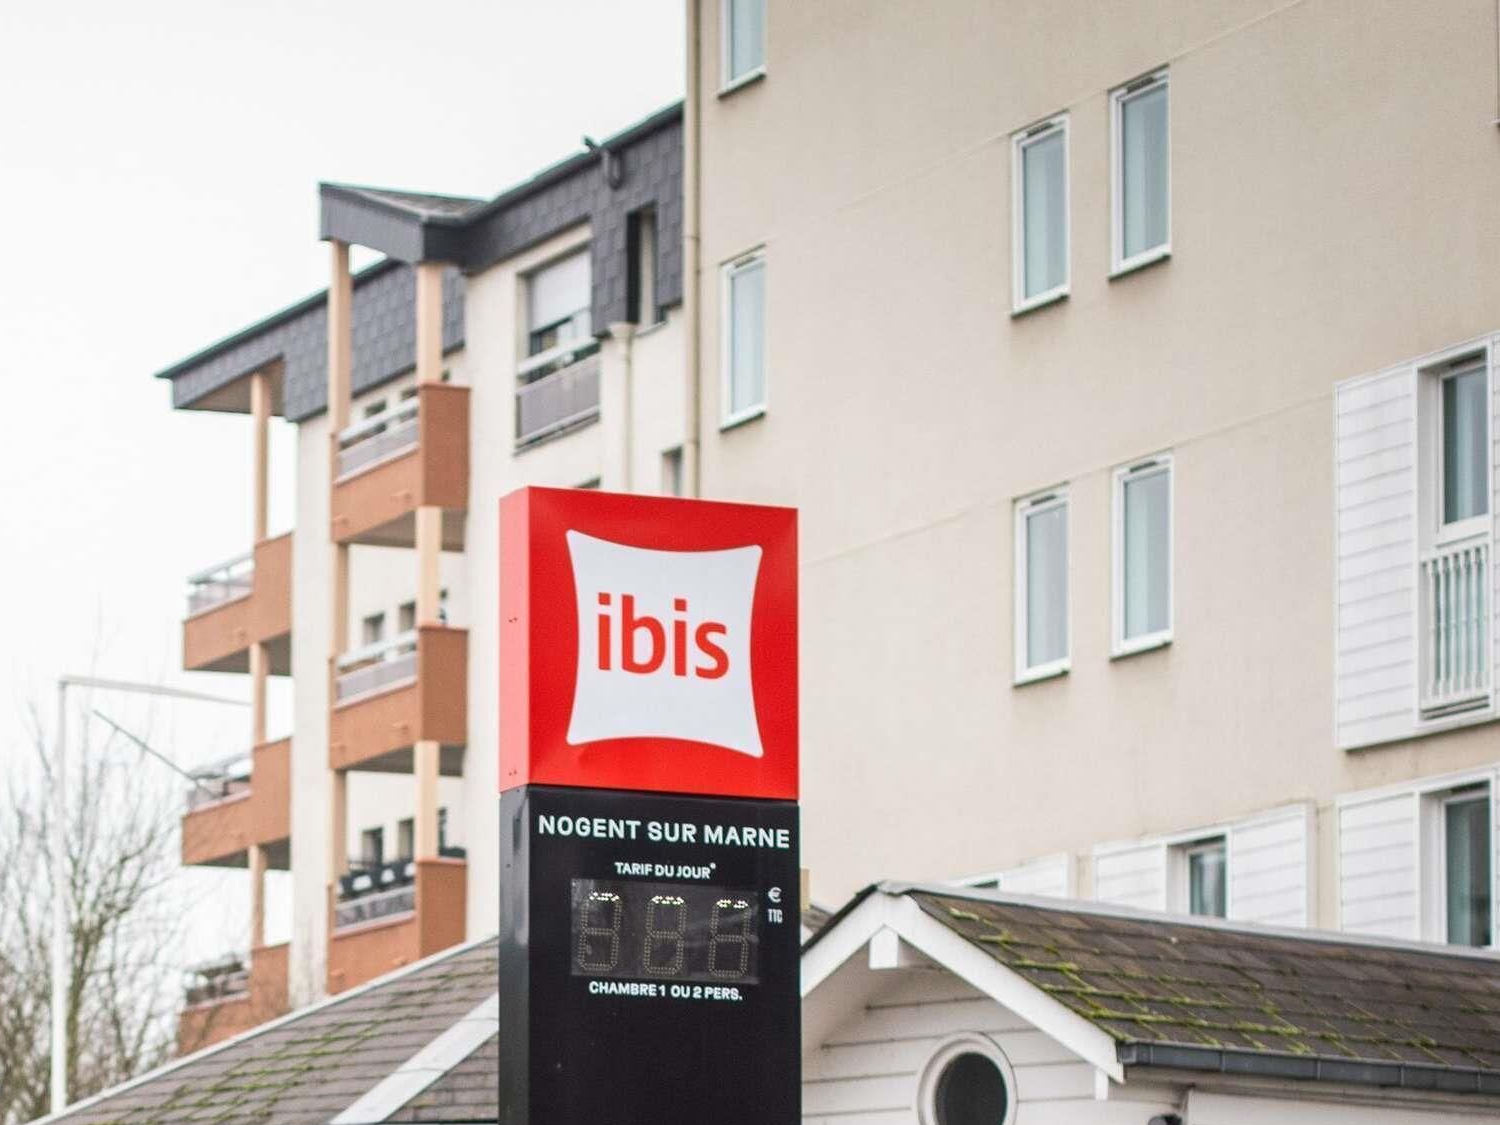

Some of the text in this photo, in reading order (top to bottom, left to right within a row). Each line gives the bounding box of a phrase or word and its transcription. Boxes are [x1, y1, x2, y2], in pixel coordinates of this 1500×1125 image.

[596, 592, 730, 679] ibis
[538, 815, 790, 849] NOGENT SUR MARNE
[614, 862, 652, 876] TARIF
[655, 864, 674, 877] DU
[768, 887, 782, 903] €
[589, 981, 743, 1000] CHAMBRE 1 OU 2 PERS.
